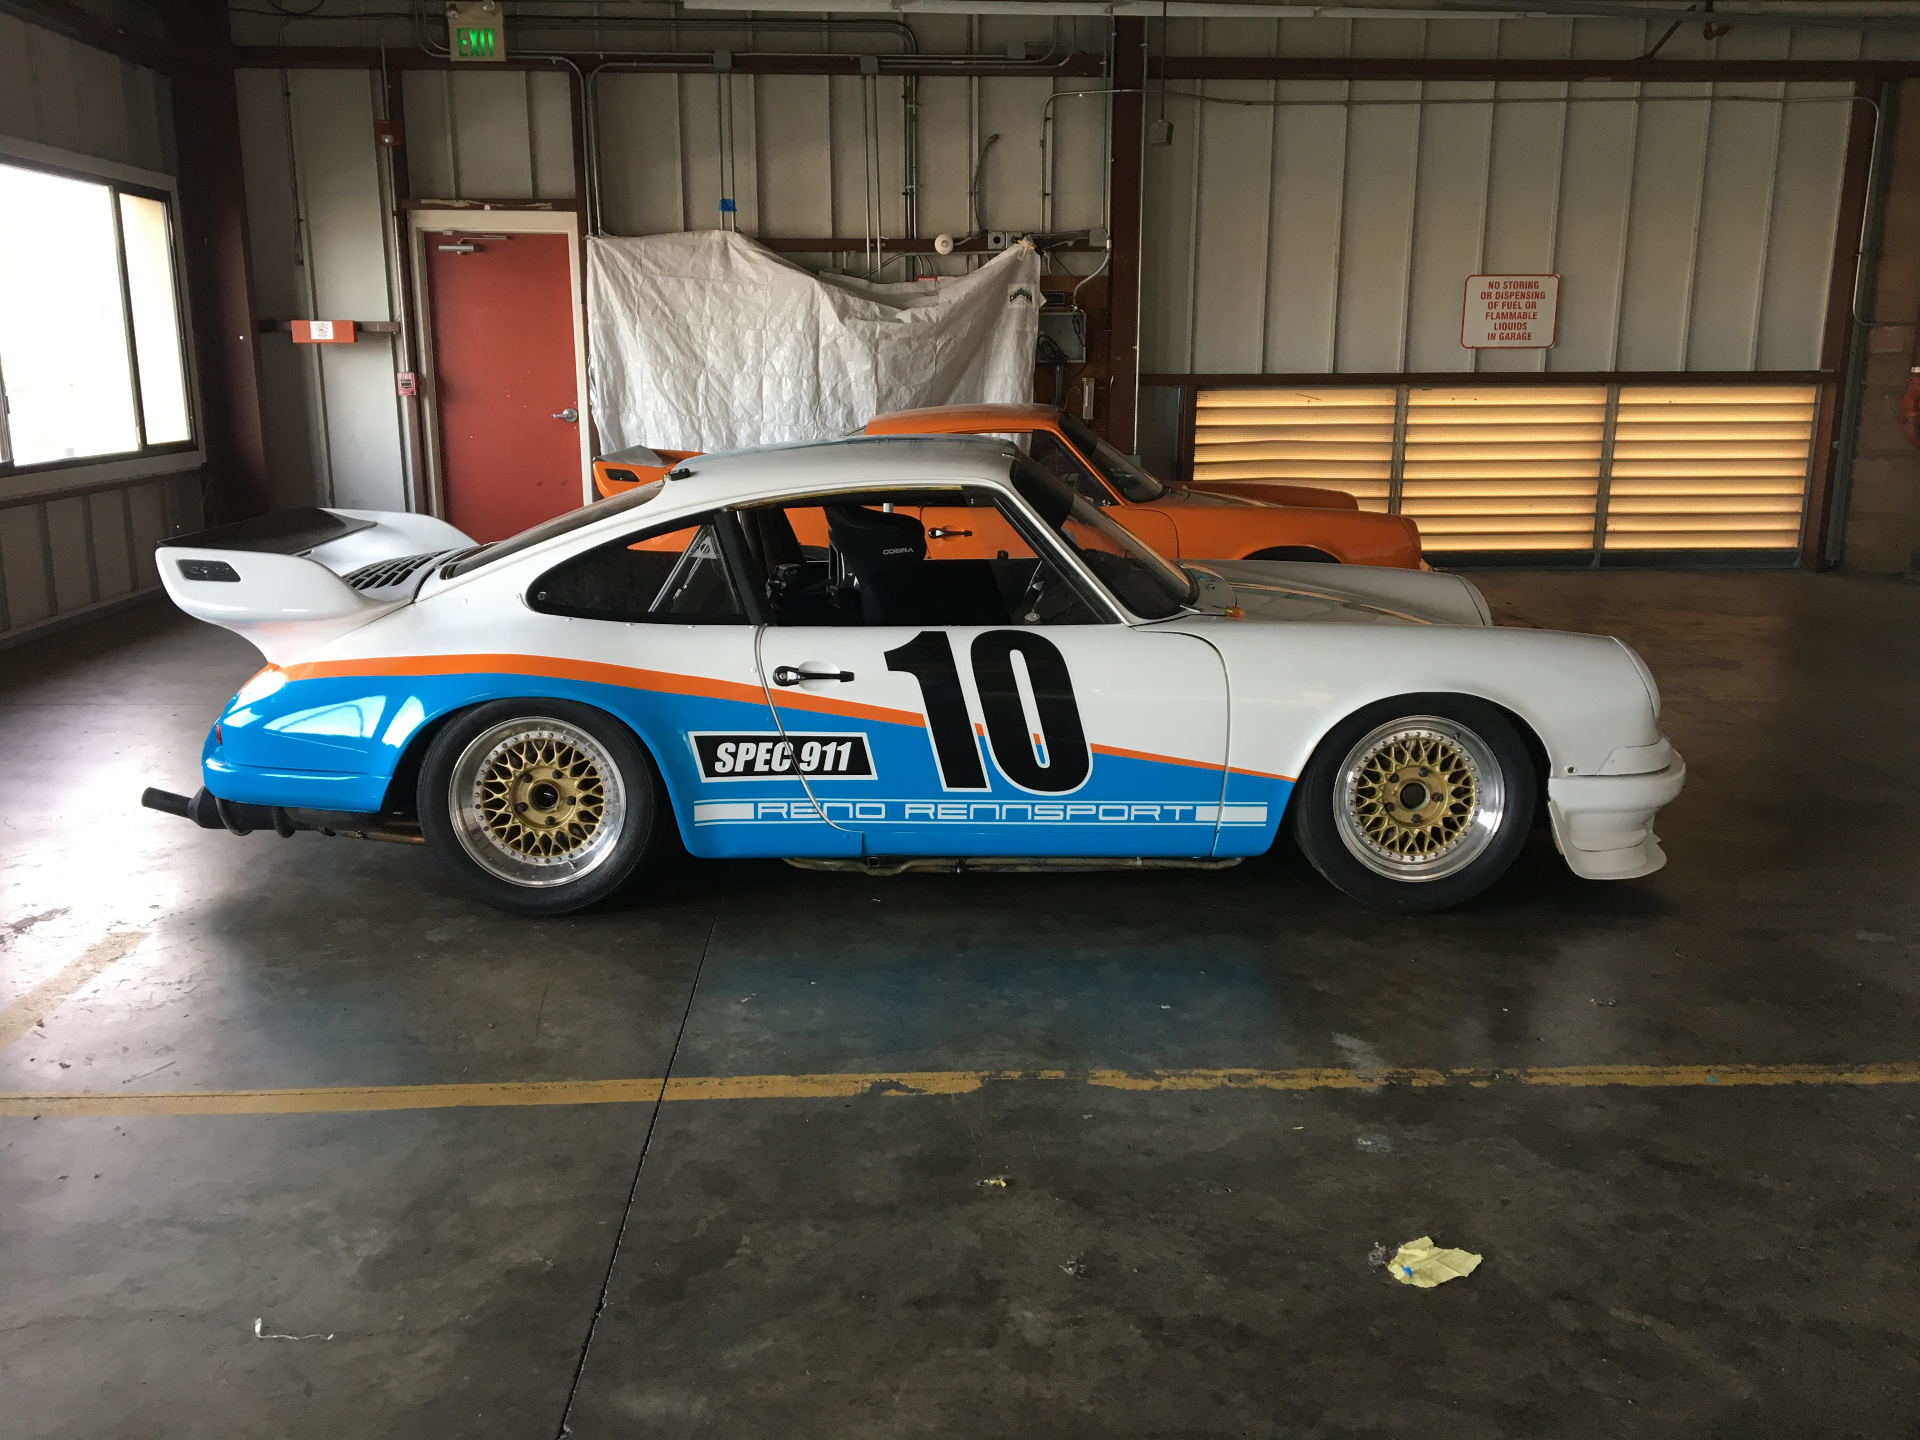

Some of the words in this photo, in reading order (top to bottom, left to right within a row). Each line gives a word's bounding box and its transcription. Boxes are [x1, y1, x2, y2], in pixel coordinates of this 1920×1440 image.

[457, 28, 494, 57] EXIT
[1488, 281, 1500, 290] NO
[1502, 281, 1539, 290] STORING
[1480, 291, 1492, 300] OR
[1495, 291, 1546, 300] DISPENSING
[1487, 301, 1499, 310] OF
[1501, 301, 1522, 310] FUEL
[1524, 301, 1537, 310] OR
[1485, 311, 1538, 320] FLAMMABLE
[1493, 322, 1528, 331] LIQUIDS
[1487, 332, 1496, 341] IN
[1498, 332, 1532, 341] GARAGE
[882, 547, 914, 555] COBRA
[883, 628, 1093, 797] 10
[714, 741, 794, 773] SPEC
[799, 741, 852, 773] 911
[757, 802, 886, 820] RENO
[904, 803, 1194, 821] RENNSPORT
